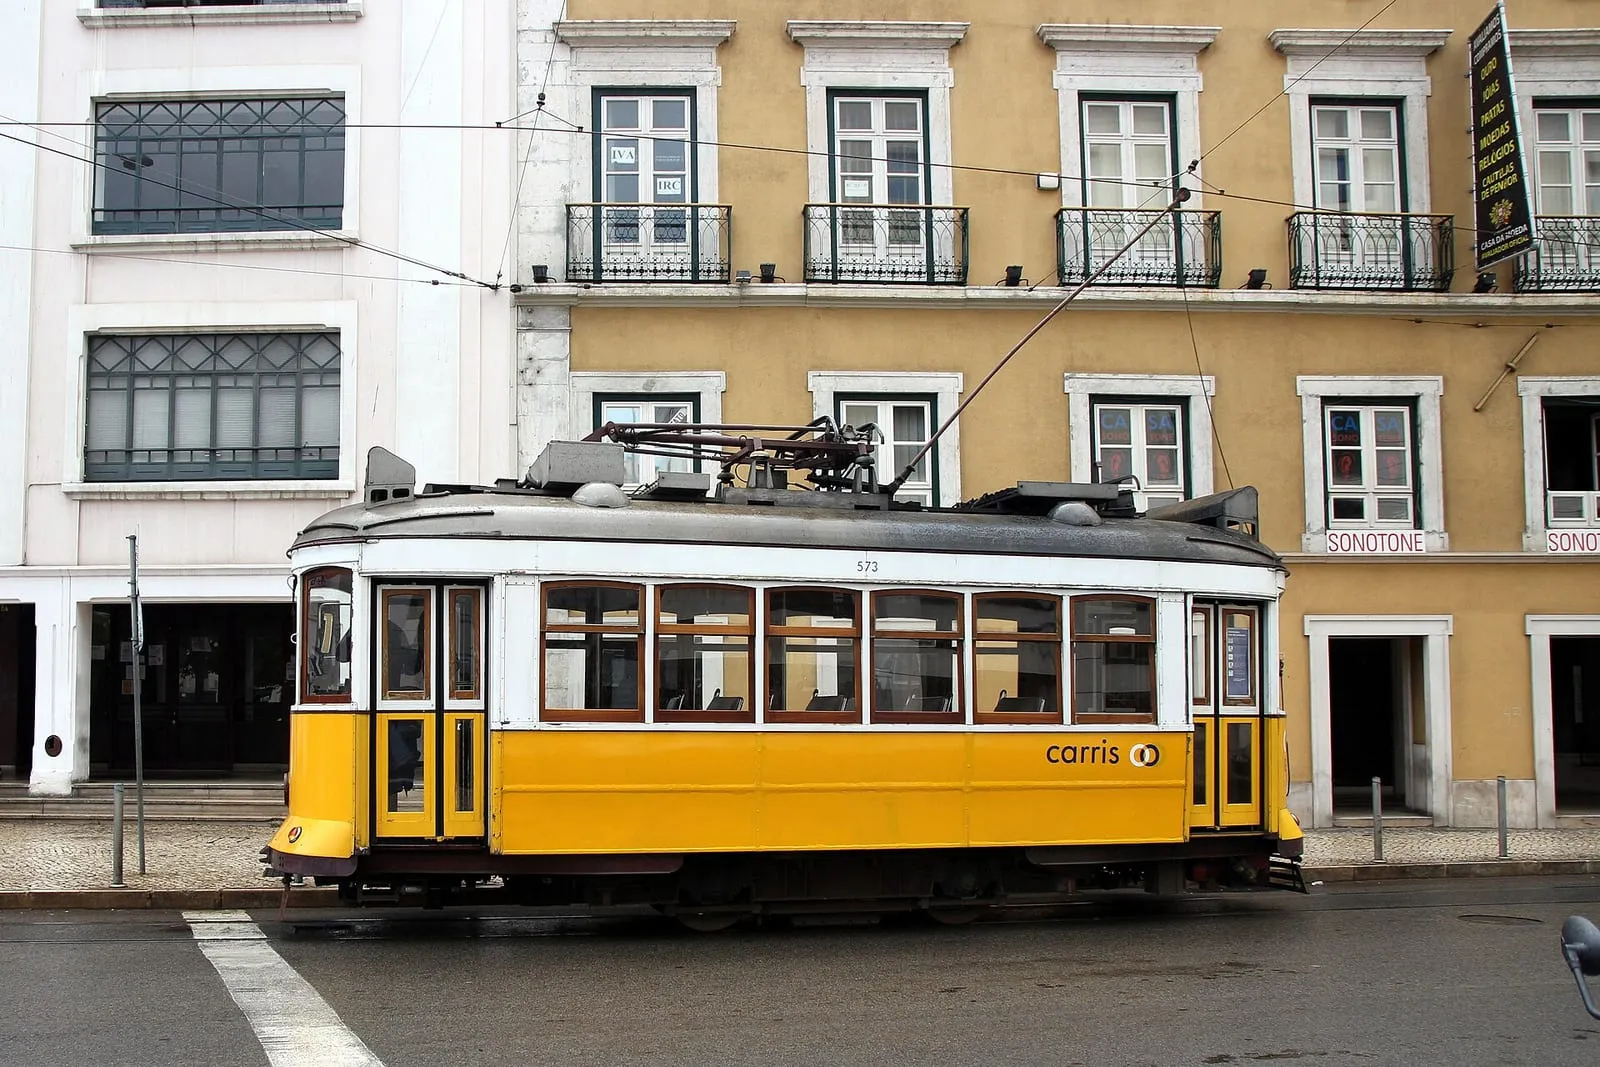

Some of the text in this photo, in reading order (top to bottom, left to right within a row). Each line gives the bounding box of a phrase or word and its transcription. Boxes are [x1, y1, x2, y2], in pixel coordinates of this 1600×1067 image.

[1481, 57, 1498, 80] OURO
[1480, 100, 1505, 127] PRATAS
[1480, 121, 1511, 151] MOEDAS
[612, 150, 635, 160] IVA
[1479, 139, 1515, 172] RELÓGIOS
[658, 180, 681, 191] IRC
[1481, 173, 1518, 201] DE PENHOR
[1480, 238, 1496, 251] CASA
[1495, 234, 1505, 244] DA
[1505, 223, 1528, 239] MOEDA
[1331, 415, 1358, 432] CA
[1328, 533, 1424, 552] SONOTONE
[1548, 532, 1600, 552] SONO
[857, 560, 879, 573] 573
[1046, 738, 1120, 765] carris
